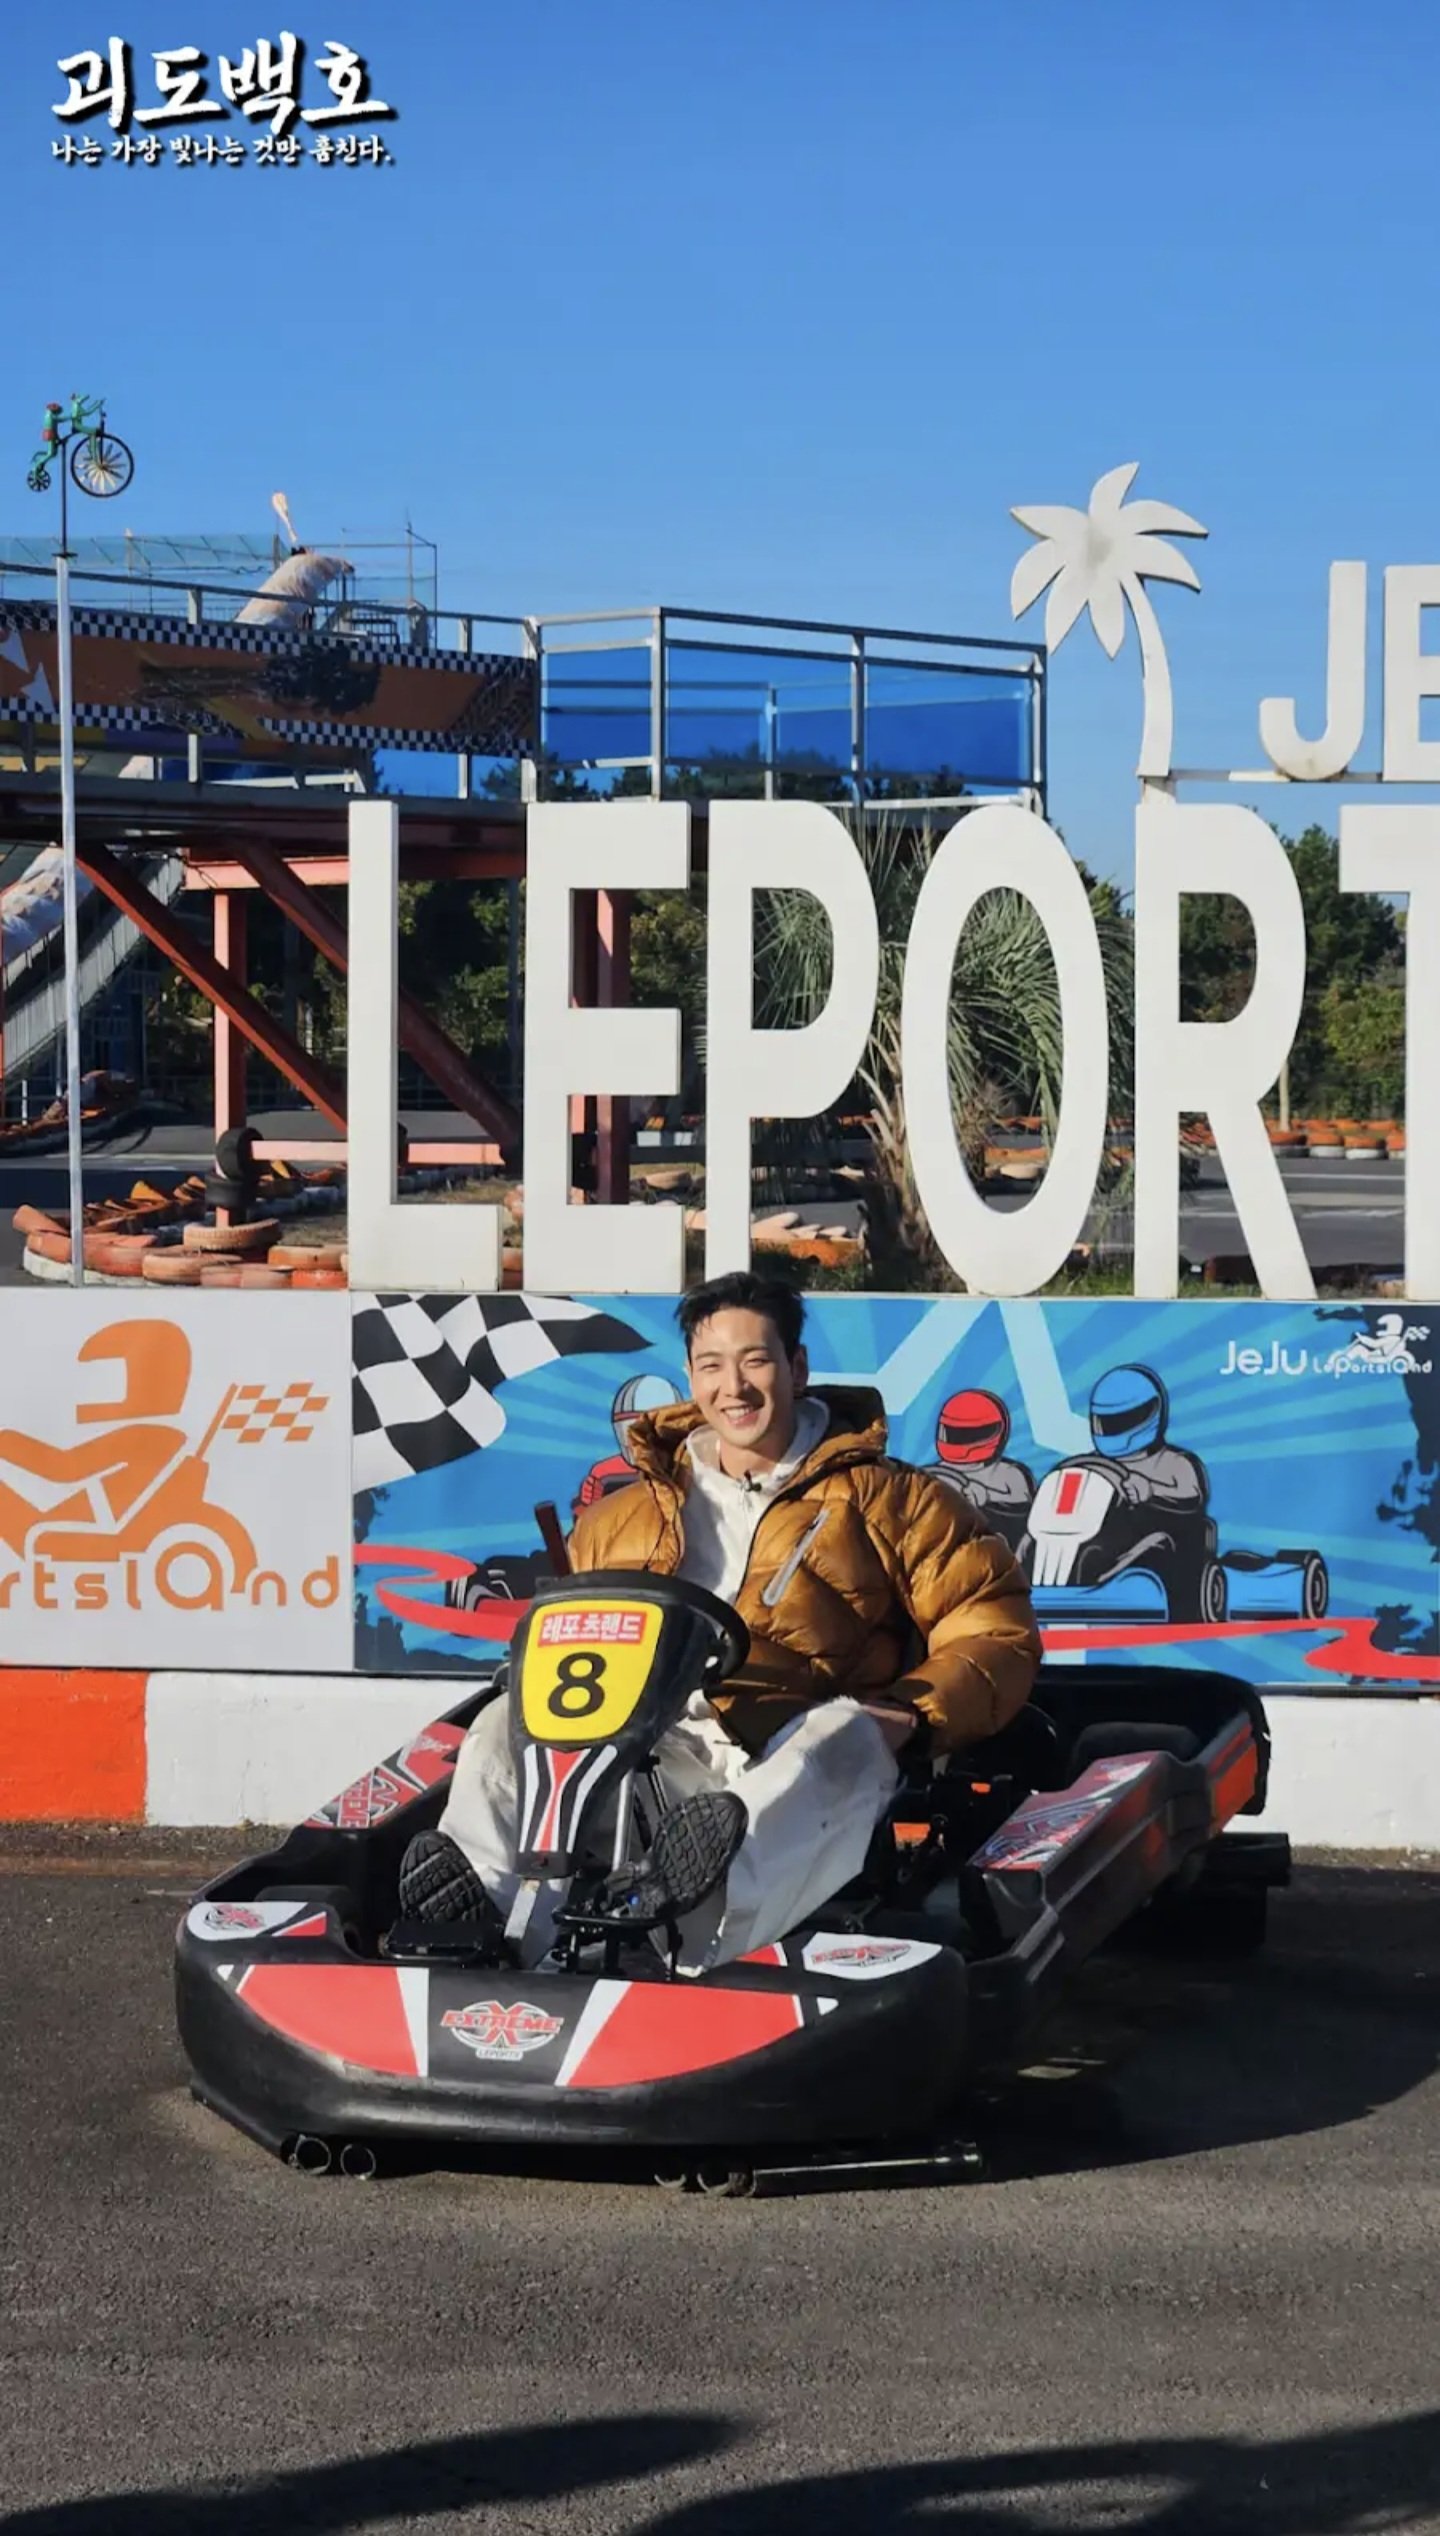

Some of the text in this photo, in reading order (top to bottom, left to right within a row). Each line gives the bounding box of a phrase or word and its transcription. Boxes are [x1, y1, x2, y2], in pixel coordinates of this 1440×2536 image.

[541, 1612, 642, 1642] 레포츠랜드
[548, 1652, 607, 1718] 8
[440, 2000, 564, 2047] EXTREME
